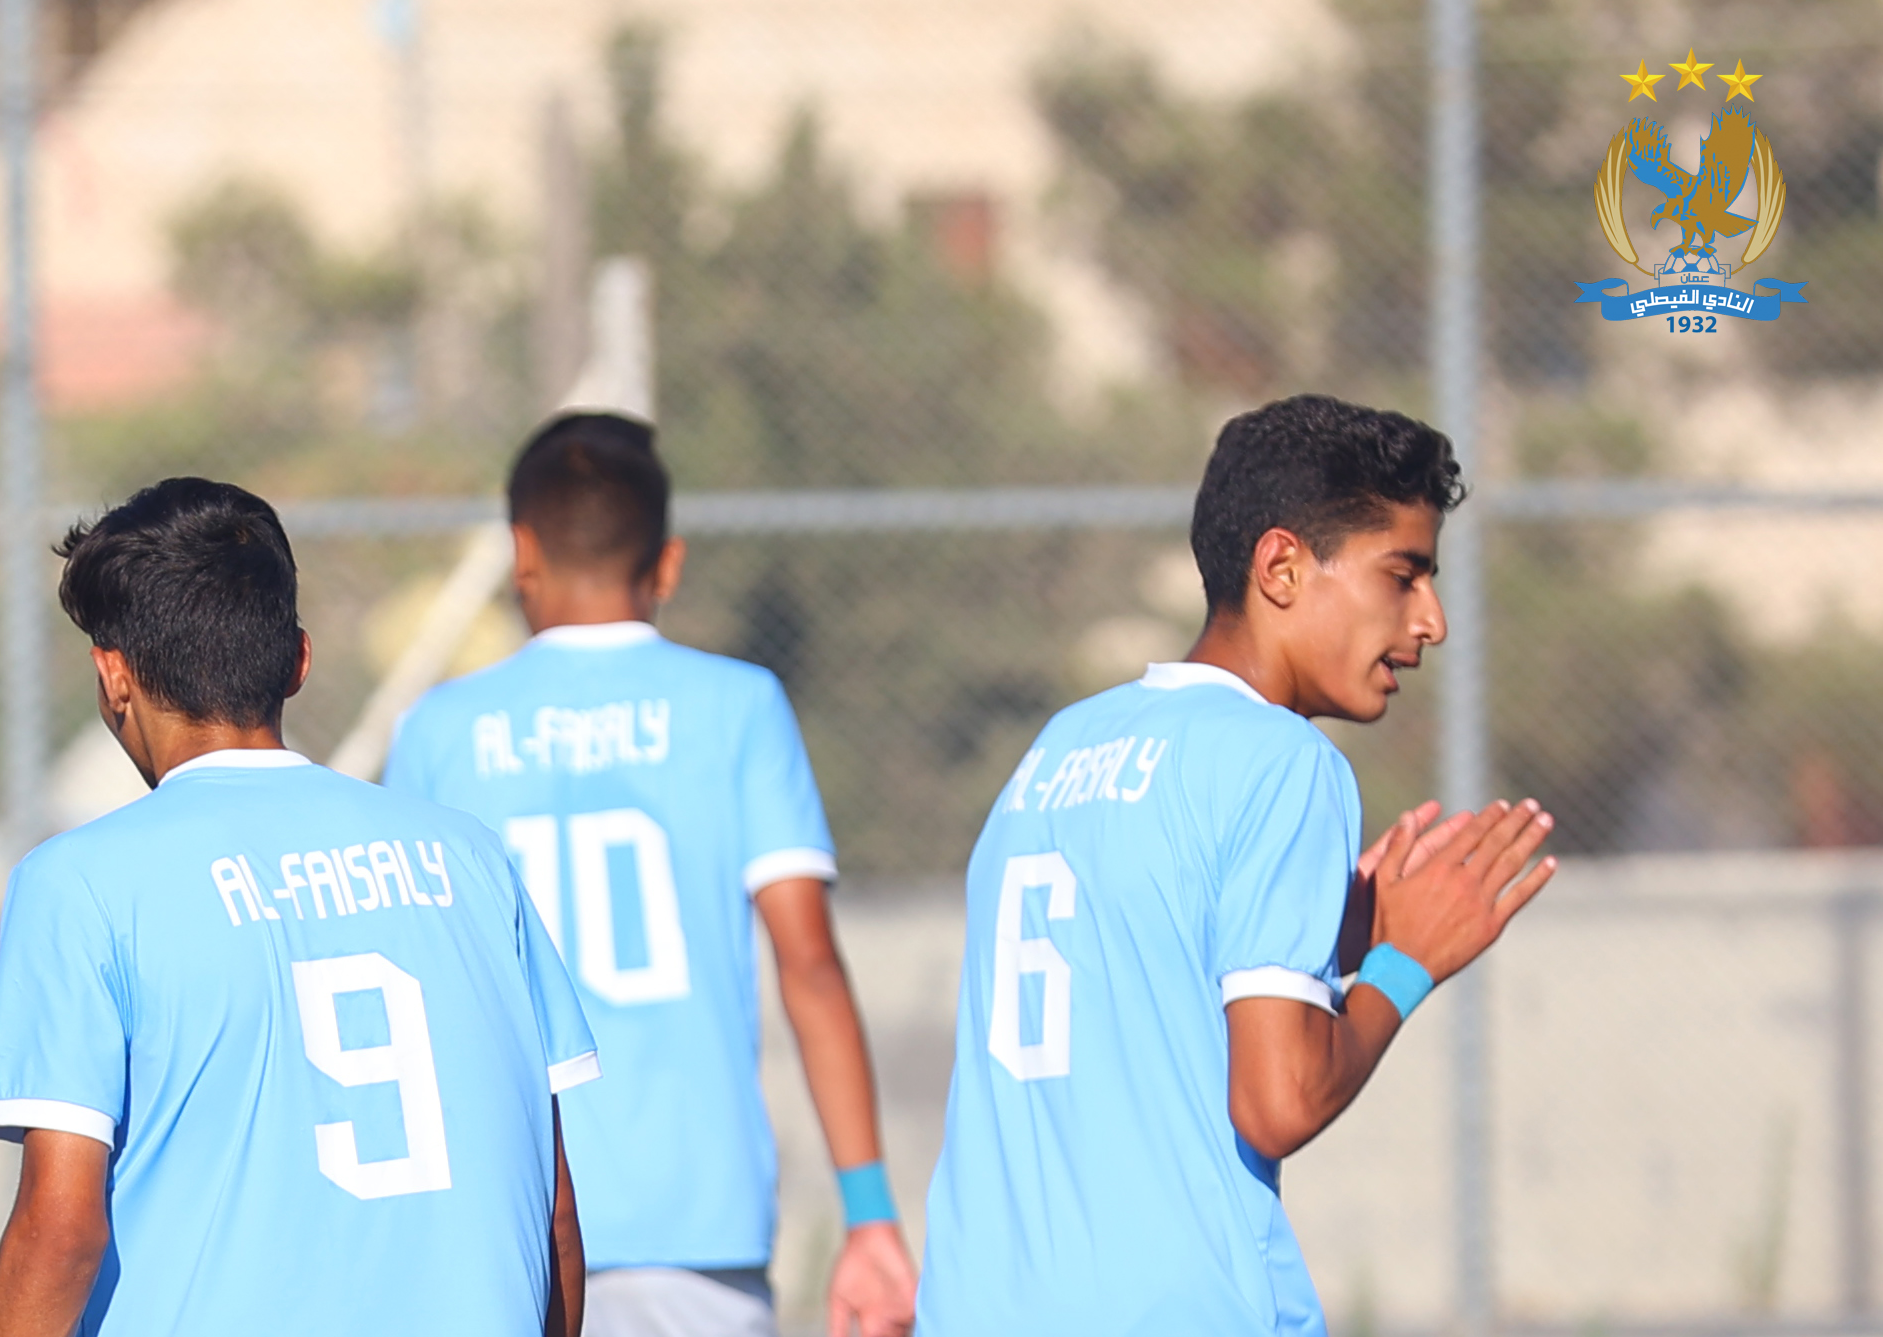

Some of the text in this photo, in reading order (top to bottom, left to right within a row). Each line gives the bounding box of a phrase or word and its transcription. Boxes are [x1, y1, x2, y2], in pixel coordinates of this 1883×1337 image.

[210, 840, 454, 927] AL-FAISALY
[506, 807, 690, 1007] 10
[988, 850, 1077, 1082] 6
[290, 951, 453, 1201] 9
